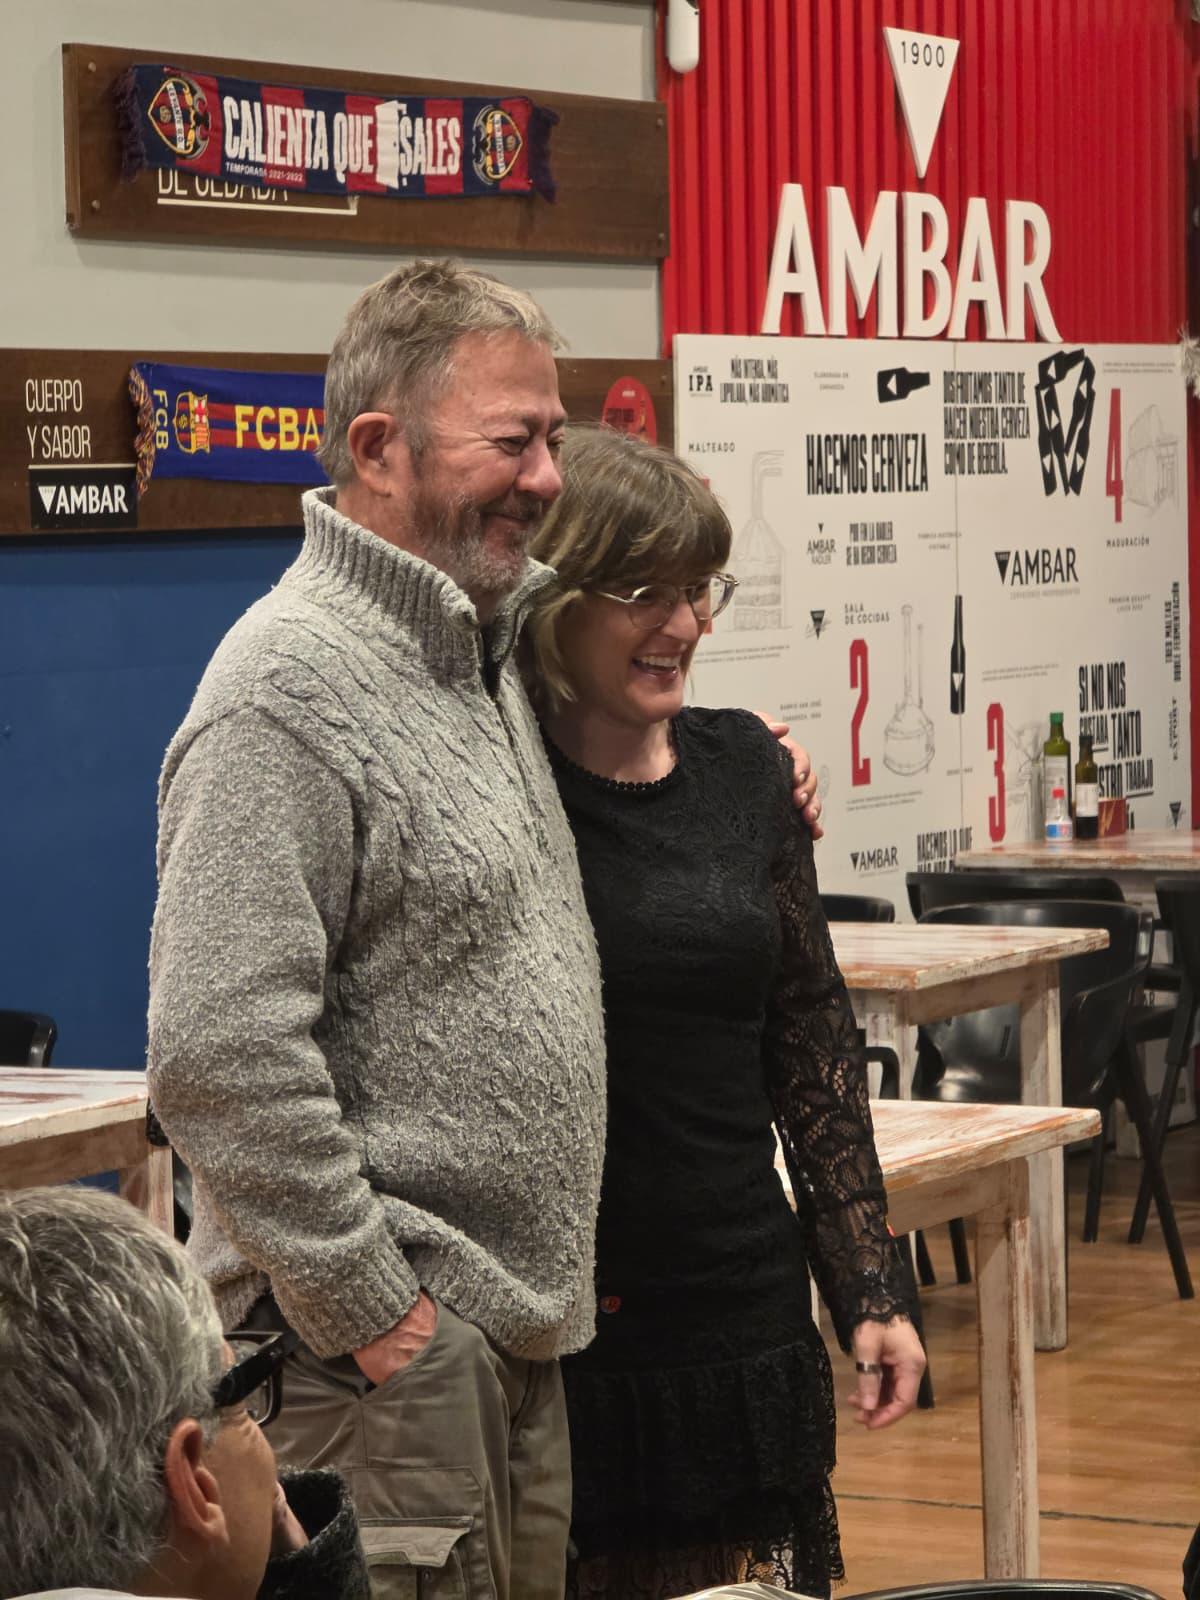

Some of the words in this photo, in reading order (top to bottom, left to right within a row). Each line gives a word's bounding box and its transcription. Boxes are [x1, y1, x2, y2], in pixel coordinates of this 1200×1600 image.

[901, 40, 945, 68] 1900
[223, 95, 329, 170] CALIENTA
[333, 111, 374, 184] QUE
[225, 161, 267, 177] TEMPORADA
[269, 170, 304, 183] 2021-2022
[760, 182, 1064, 343] AMBAR
[25, 378, 82, 413] CUERPO
[689, 374, 713, 391] IPA
[943, 370, 993, 404] DISFRUTAMOS
[994, 371, 1015, 404] TANTO
[1017, 372, 1026, 404] DE
[152, 388, 168, 450] FCB
[943, 406, 967, 440] HACER
[968, 406, 999, 439] NUESTRA
[1001, 406, 1030, 439] CERVEZA
[26, 424, 38, 458] Y
[41, 423, 92, 459] SABOR
[688, 442, 736, 453] MALTEADO
[1106, 388, 1124, 523] 4
[806, 433, 867, 495] HACEMOS
[871, 432, 929, 492] CERVEZA
[944, 442, 965, 475] COMO
[967, 442, 976, 475] DE
[56, 484, 129, 515] AMBAR
[807, 538, 837, 554] AMBAR
[1106, 536, 1150, 548] MADURACIÓN
[1010, 547, 1079, 586] AMBAR
[845, 603, 864, 613] SALA
[845, 614, 853, 625] DE
[857, 611, 890, 624] COCIDAS
[1079, 664, 1089, 713] SI
[1091, 663, 1104, 711] NO
[1106, 661, 1126, 710] NOS
[849, 638, 871, 787] 2
[1111, 710, 1142, 761] TANTO
[986, 702, 1006, 843] 3
[1125, 759, 1154, 792] TRABAJO
[859, 845, 899, 871] AMBAR
[917, 829, 948, 862] HACEMOS
[959, 825, 973, 852] QUE
